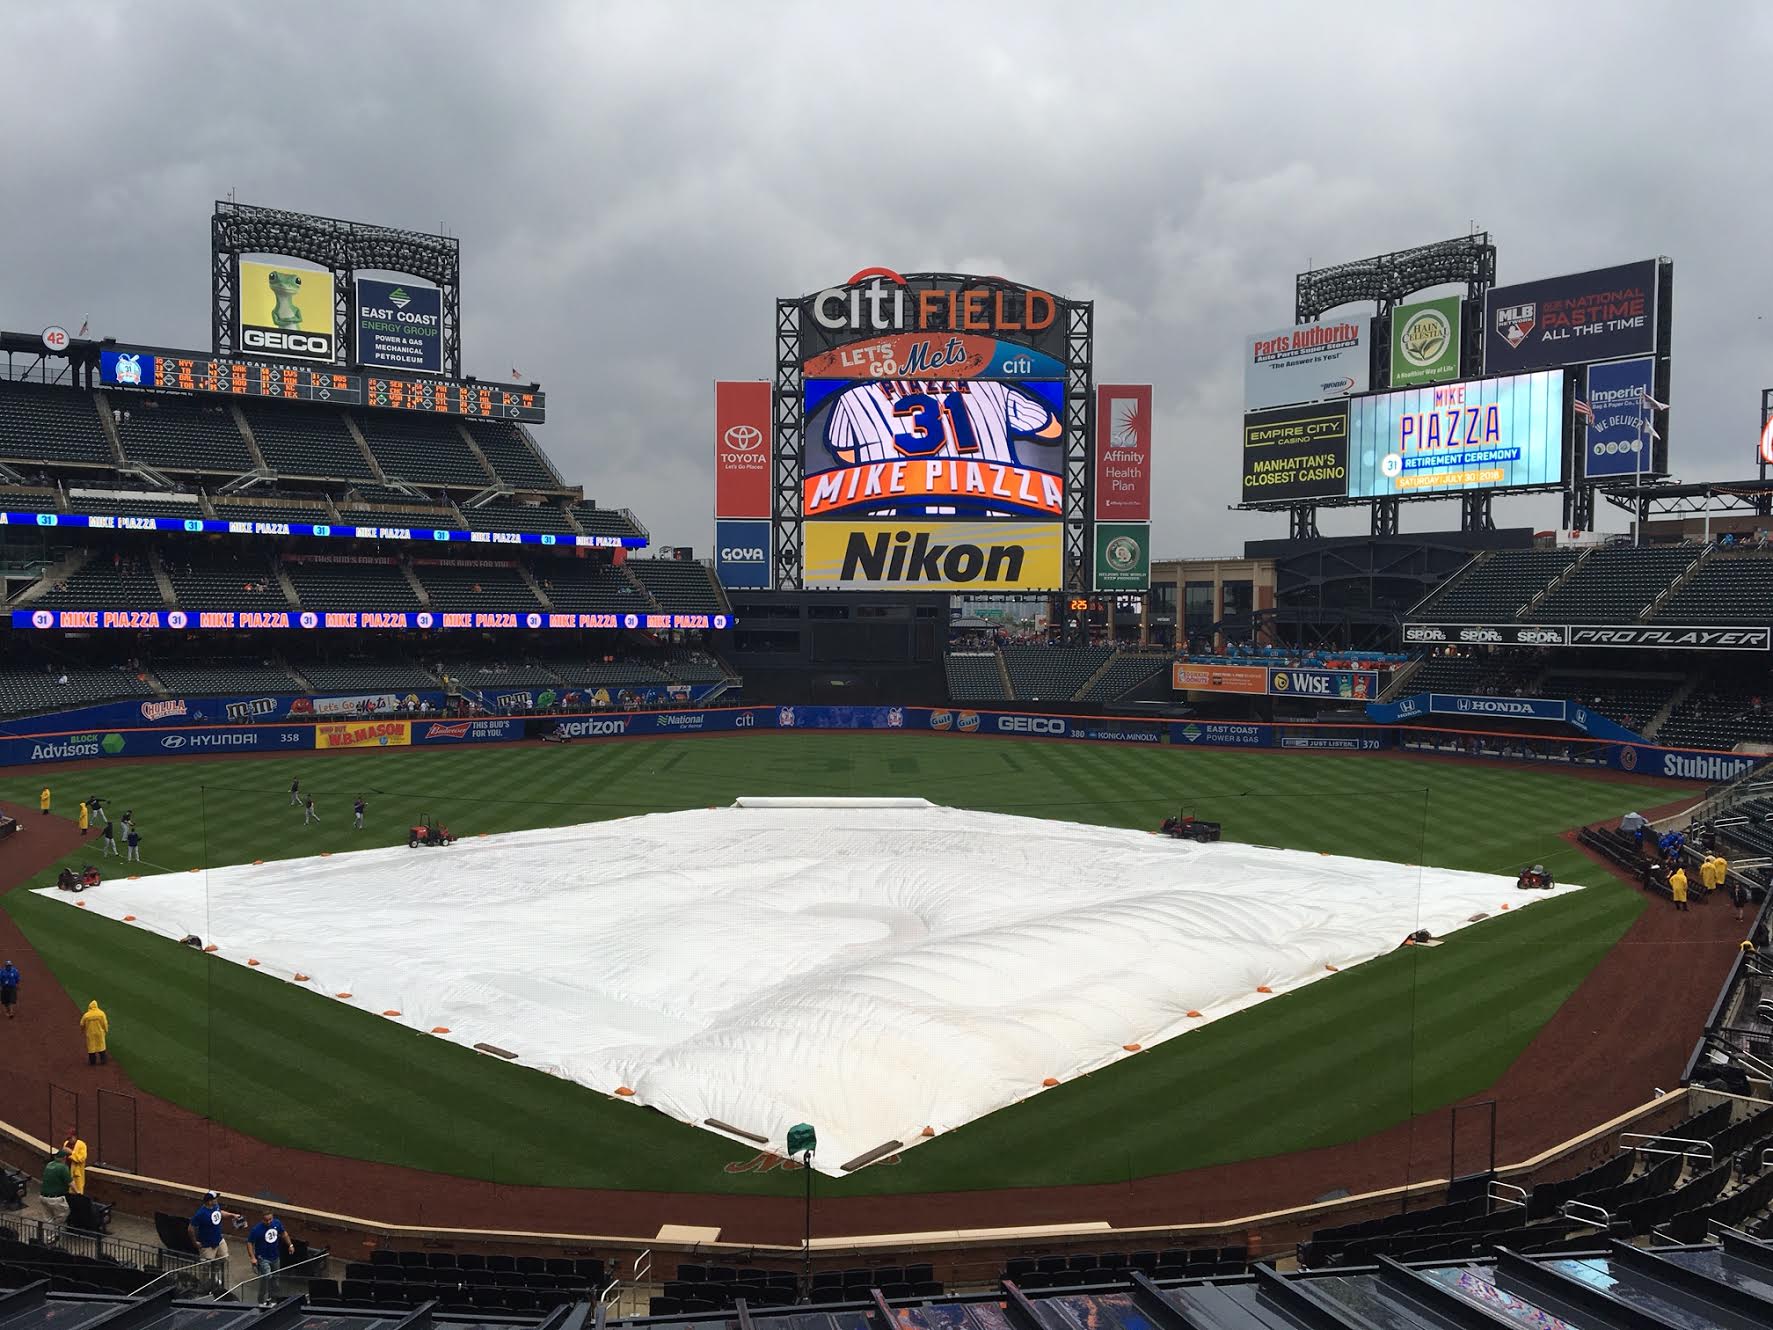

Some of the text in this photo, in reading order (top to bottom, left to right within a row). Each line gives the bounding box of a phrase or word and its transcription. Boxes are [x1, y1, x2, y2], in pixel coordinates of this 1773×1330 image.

[814, 279, 1056, 330] citi FIELD
[1566, 288, 1644, 309] NATIONAL
[362, 307, 437, 325] EAST COAST
[1499, 306, 1533, 322] MLB
[1542, 300, 1644, 328] PASTIME
[361, 321, 438, 337] ENERGY GROUP
[1414, 323, 1437, 333] HAIN
[1499, 318, 1532, 326] NETWORK
[47, 332, 64, 344] 42
[1254, 323, 1358, 355] Parts Authority
[1402, 328, 1446, 343] CELESTIAL
[1542, 327, 1570, 341] ALL
[1573, 323, 1603, 336] THE
[244, 330, 328, 353] GEICO
[1300, 346, 1325, 355] Super
[1327, 341, 1355, 349] Stores
[376, 344, 423, 355] MECHANICAL
[841, 342, 895, 367] LET'S
[899, 338, 966, 375] Mets
[213, 358, 311, 372] AMERICAN LEAGUE
[376, 353, 423, 363] PETROLEUM
[1003, 356, 1031, 374] citi
[1286, 358, 1313, 367] Answer
[870, 361, 897, 377] GO
[416, 379, 460, 387] NATIONAL
[1435, 386, 1465, 407] MIKE
[892, 391, 979, 456] 31
[1400, 404, 1500, 452] PIAZZA
[1595, 415, 1643, 432] WE DELIVER
[1250, 422, 1340, 440] EMPIRE CITY
[1278, 436, 1310, 445] CASINO
[720, 454, 766, 463] TOYOTA
[1104, 451, 1144, 464] Affinity
[1254, 454, 1335, 473] MANHATTAN'S
[1387, 449, 1518, 470] 31 RETIREMENT CEREMONY
[1106, 467, 1141, 478] Health
[1245, 467, 1344, 486] CLOSEST CASINO
[810, 460, 1062, 509] MIKE PIAZZA
[1112, 480, 1135, 491] Plan
[1400, 476, 1438, 487] SATURDAY
[1443, 474, 1464, 483] JULY
[1466, 474, 1475, 482] 30
[42, 516, 51, 524] 31
[88, 516, 115, 528] MIKE
[118, 517, 156, 530] PIAZZA
[189, 521, 198, 530] 31
[229, 522, 253, 533] MIKE
[256, 523, 290, 534] PIAZZA
[356, 527, 377, 538] MIKE
[380, 528, 410, 539] PIAZZA
[471, 532, 490, 542] MIKE
[493, 533, 522, 543] PIAZZA
[576, 536, 594, 546] MIKE
[596, 537, 622, 546] PIAZZA
[722, 548, 764, 560] GOYA
[840, 531, 1024, 582] Nikon
[37, 615, 47, 624] 31
[60, 612, 98, 628] MIKE
[104, 612, 159, 628] PIAZZA
[172, 616, 180, 624] 31
[200, 613, 234, 628] MIKE
[240, 613, 289, 628] PIAZZA
[326, 613, 357, 627] MIKE
[362, 613, 407, 627] PIAZZA
[443, 614, 472, 627] MIKE
[476, 614, 517, 627] PIAZZA
[550, 615, 576, 627] MIKE
[579, 615, 617, 628] PIAZZA
[647, 615, 671, 628] MIKE
[674, 615, 709, 628] PIAZZA
[1573, 630, 1766, 644] PRO PLAYER
[1293, 673, 1330, 693] WISE
[141, 700, 186, 720] CHOLULA
[319, 704, 338, 712] Let's
[1397, 710, 1422, 718] HONDA
[1472, 701, 1535, 714] HONDA
[668, 715, 704, 724] National
[736, 714, 754, 726] citi
[932, 716, 951, 724] Gulf
[958, 718, 978, 726] Gulf
[998, 716, 1065, 734] GEICO
[431, 724, 467, 735] Budweiser
[560, 718, 624, 736] verizon
[1071, 730, 1084, 738] 380
[1207, 725, 1258, 734] EAST COAST
[71, 735, 98, 743] BLOCK
[190, 734, 257, 746] HYUNDAI
[281, 734, 299, 742] 358
[1098, 732, 1157, 741] KONICA MINOLTA
[31, 742, 98, 759] Advisors
[1363, 740, 1379, 748] 370
[213, 1214, 219, 1222] 31
